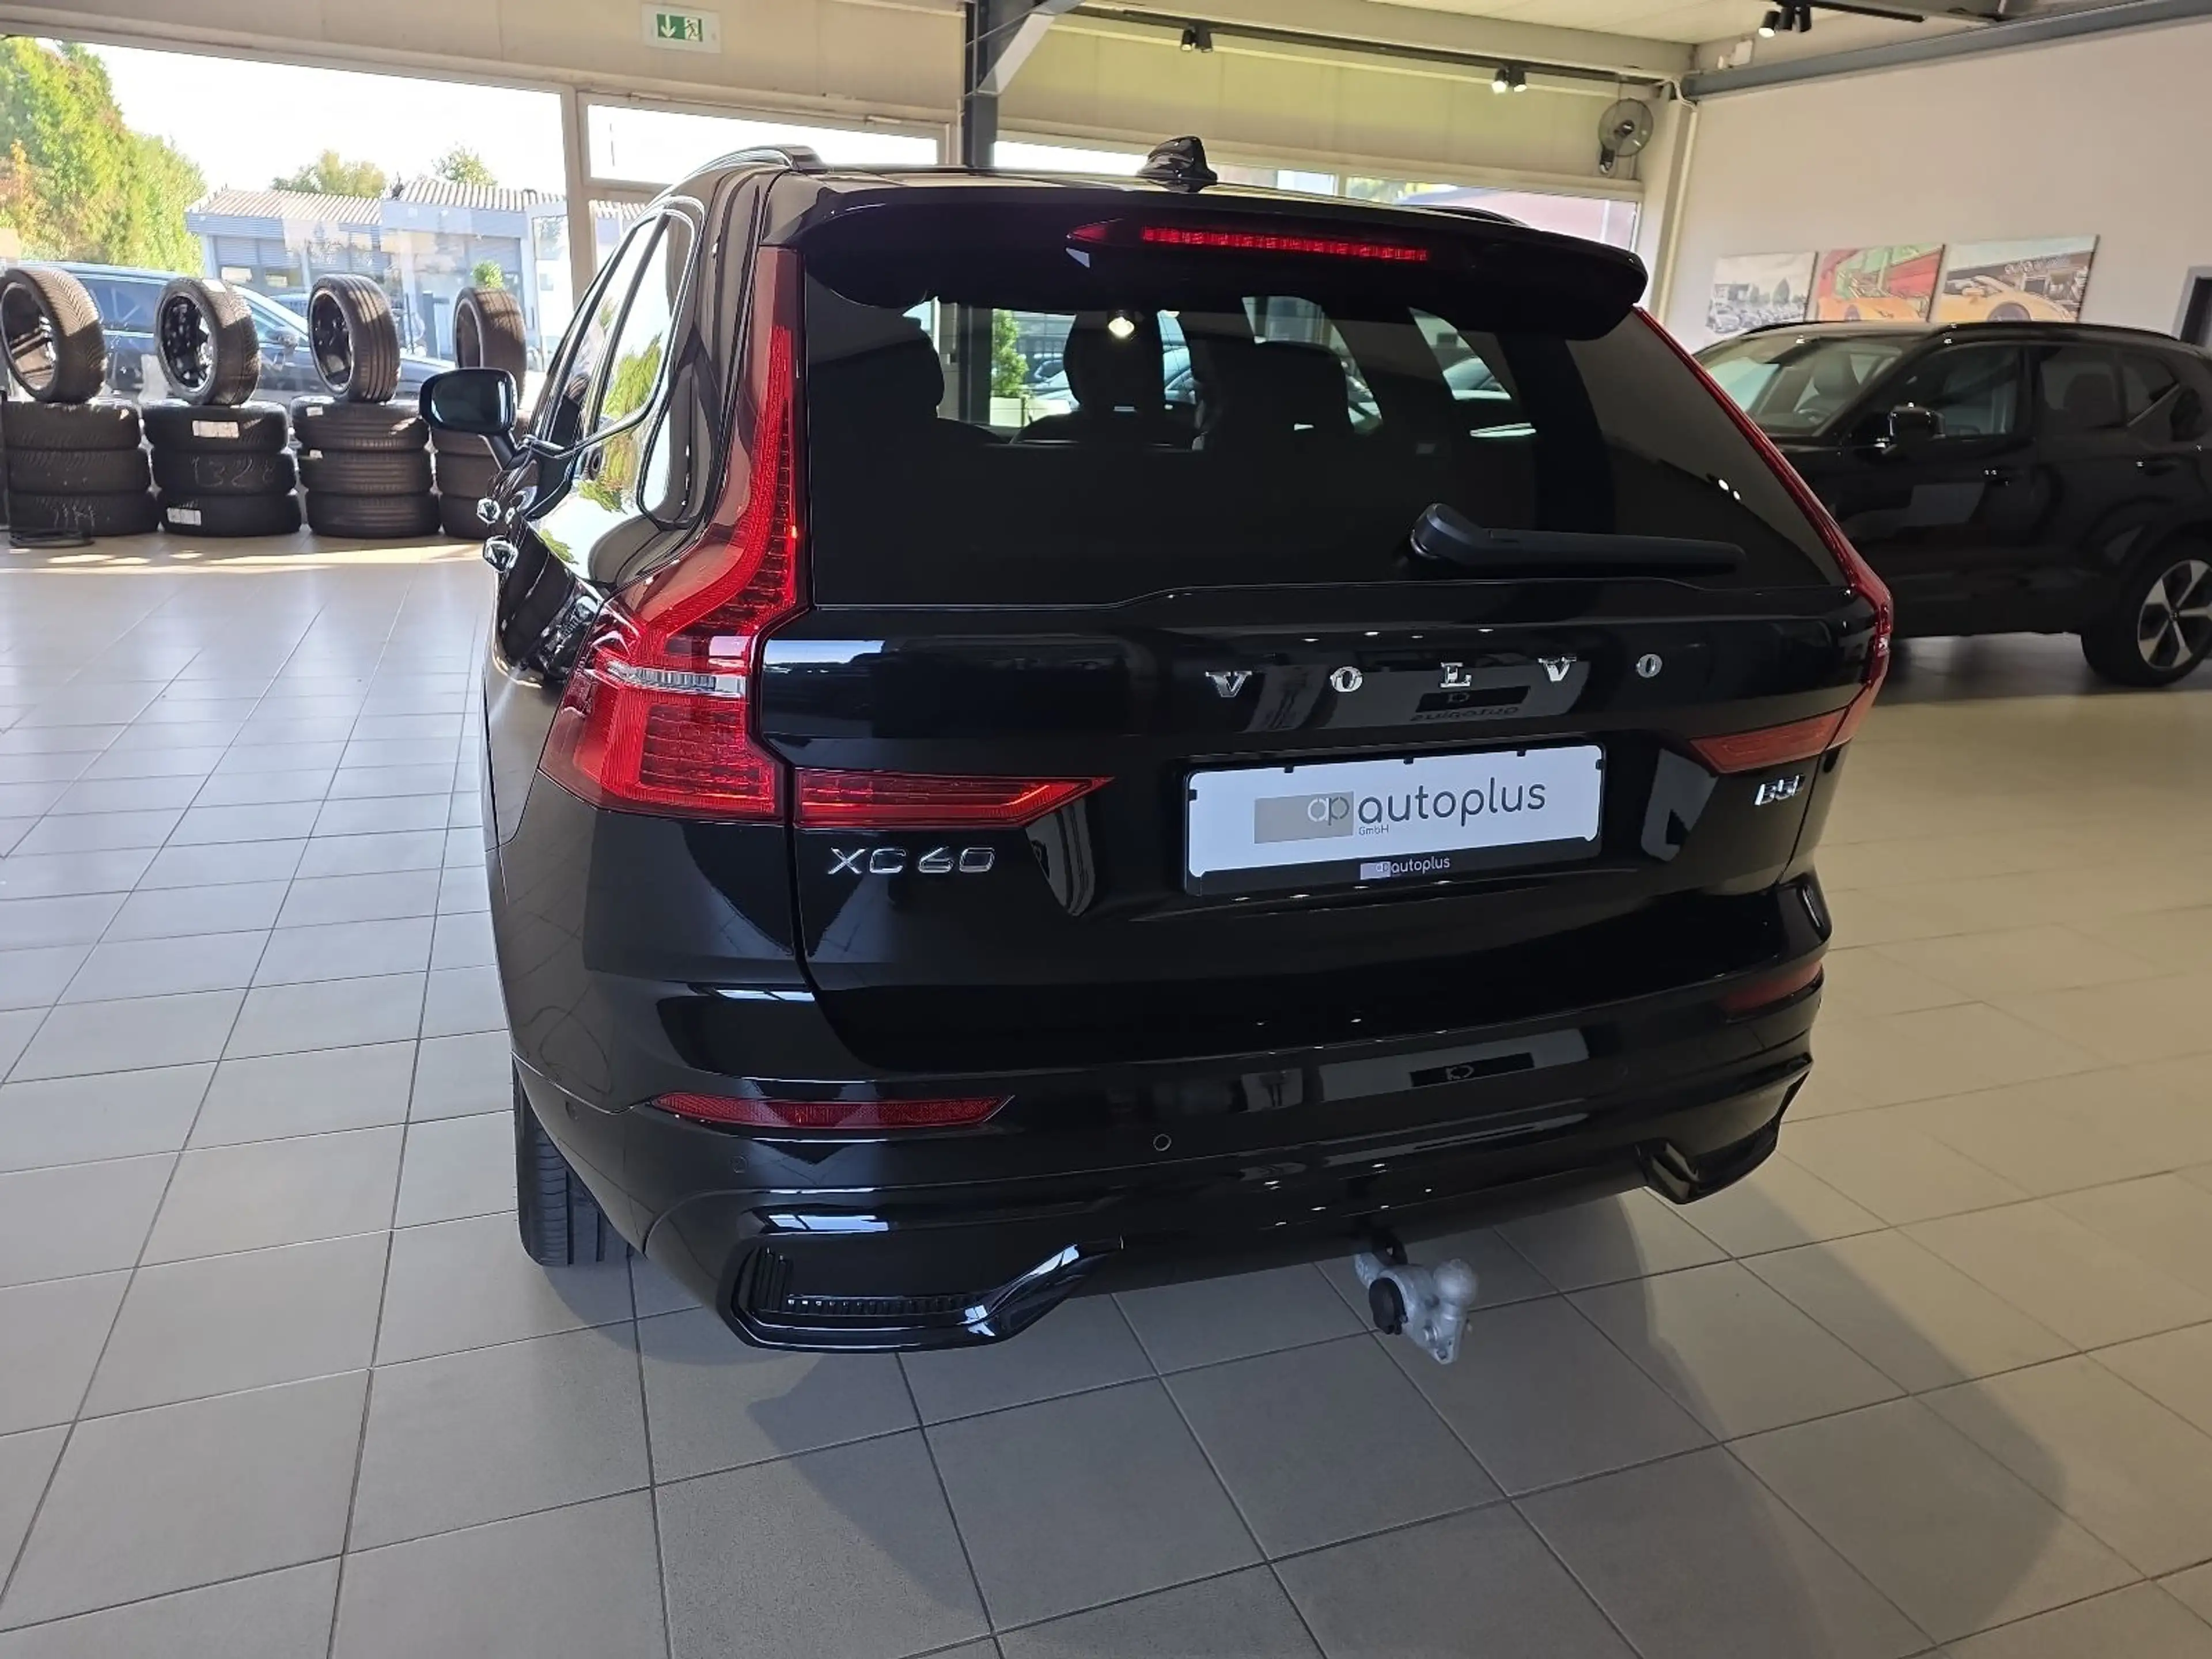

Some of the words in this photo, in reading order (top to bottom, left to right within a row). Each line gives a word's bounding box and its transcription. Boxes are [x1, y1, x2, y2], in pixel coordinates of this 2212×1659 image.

[1205, 653, 1663, 698] VOLVO
[1358, 777, 1546, 827] autoplus
[1358, 824, 1389, 835] GmbH
[827, 847, 995, 874] XC60
[1391, 855, 1450, 874] autoplus
